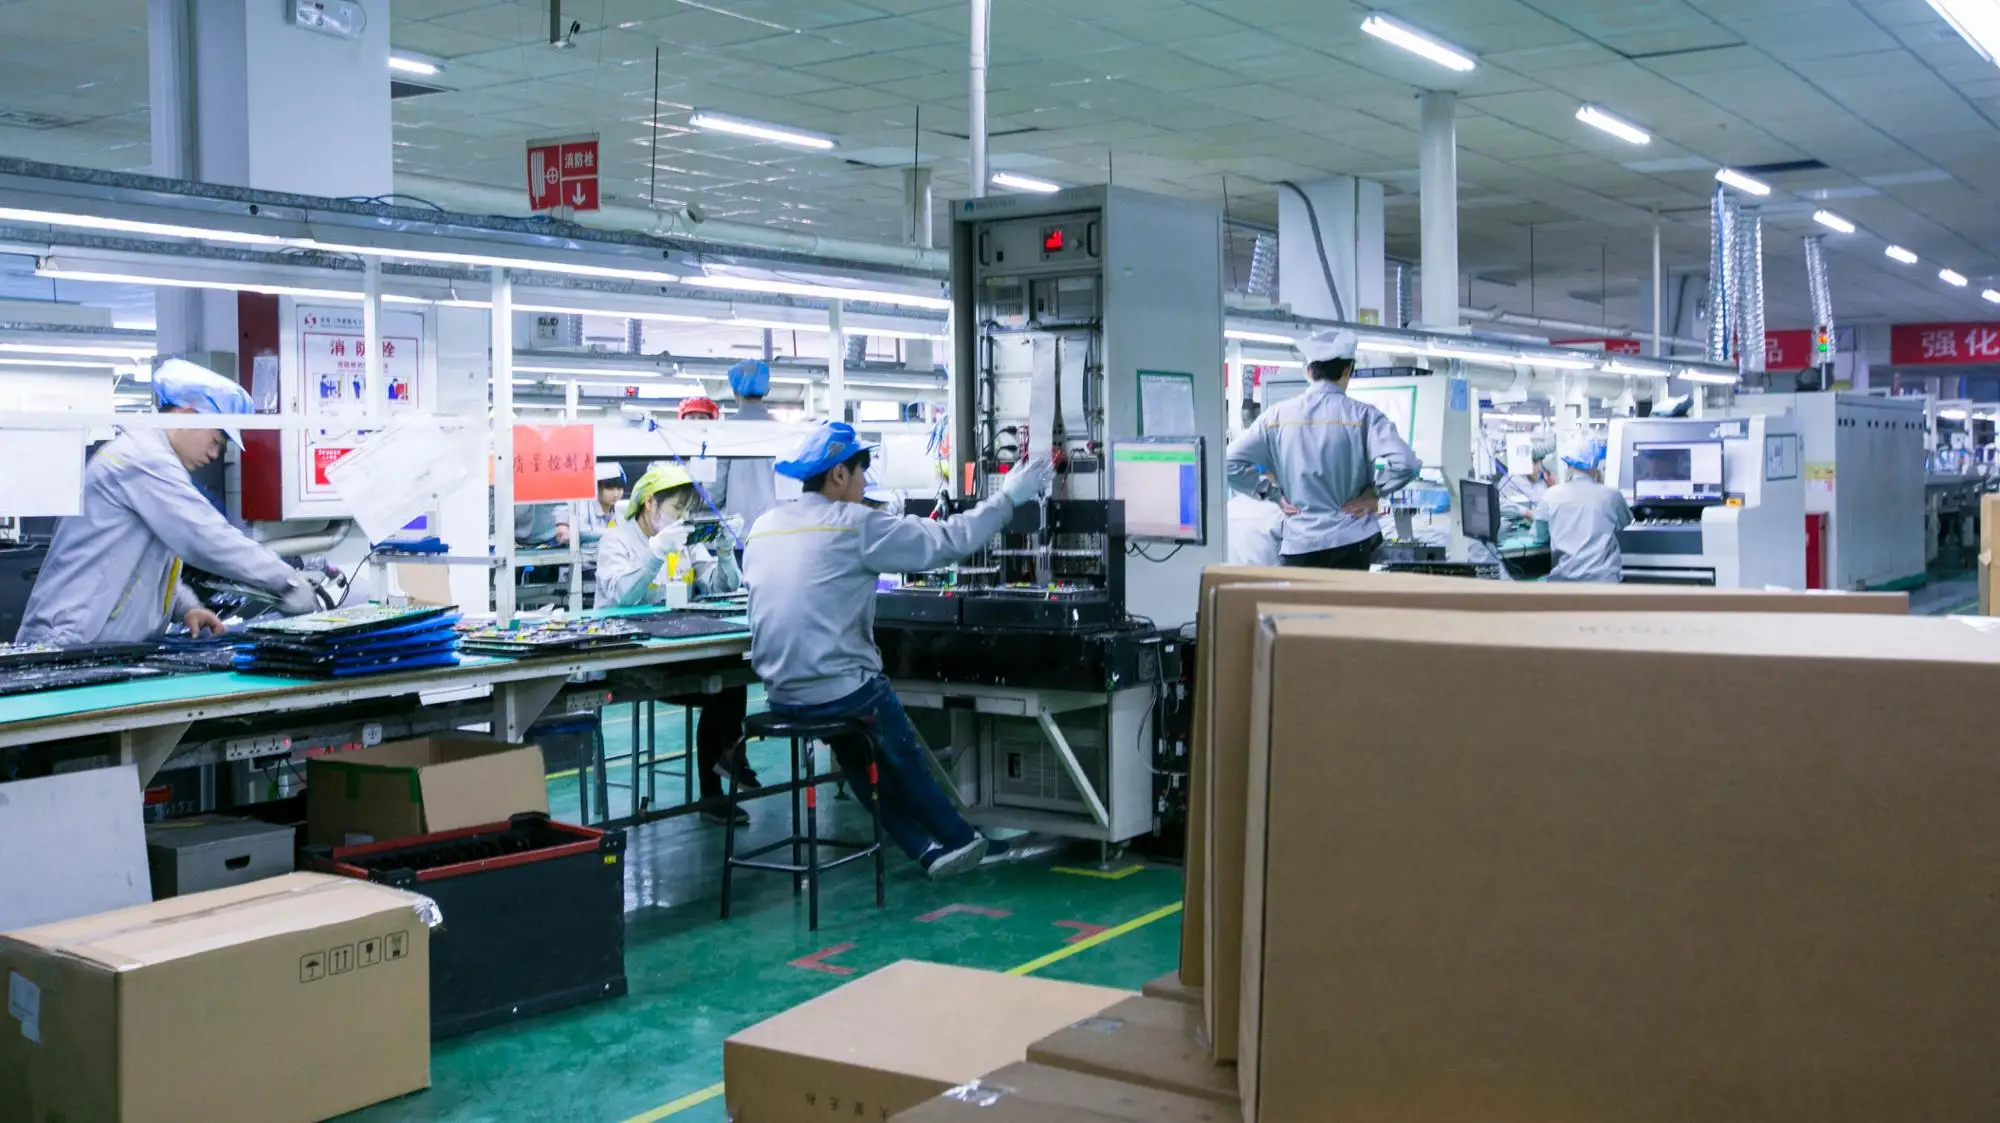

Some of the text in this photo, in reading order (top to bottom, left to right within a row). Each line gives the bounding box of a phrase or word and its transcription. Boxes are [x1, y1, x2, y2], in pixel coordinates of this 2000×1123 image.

[564, 149, 594, 169] 消防栓
[1921, 327, 2000, 359] 强化
